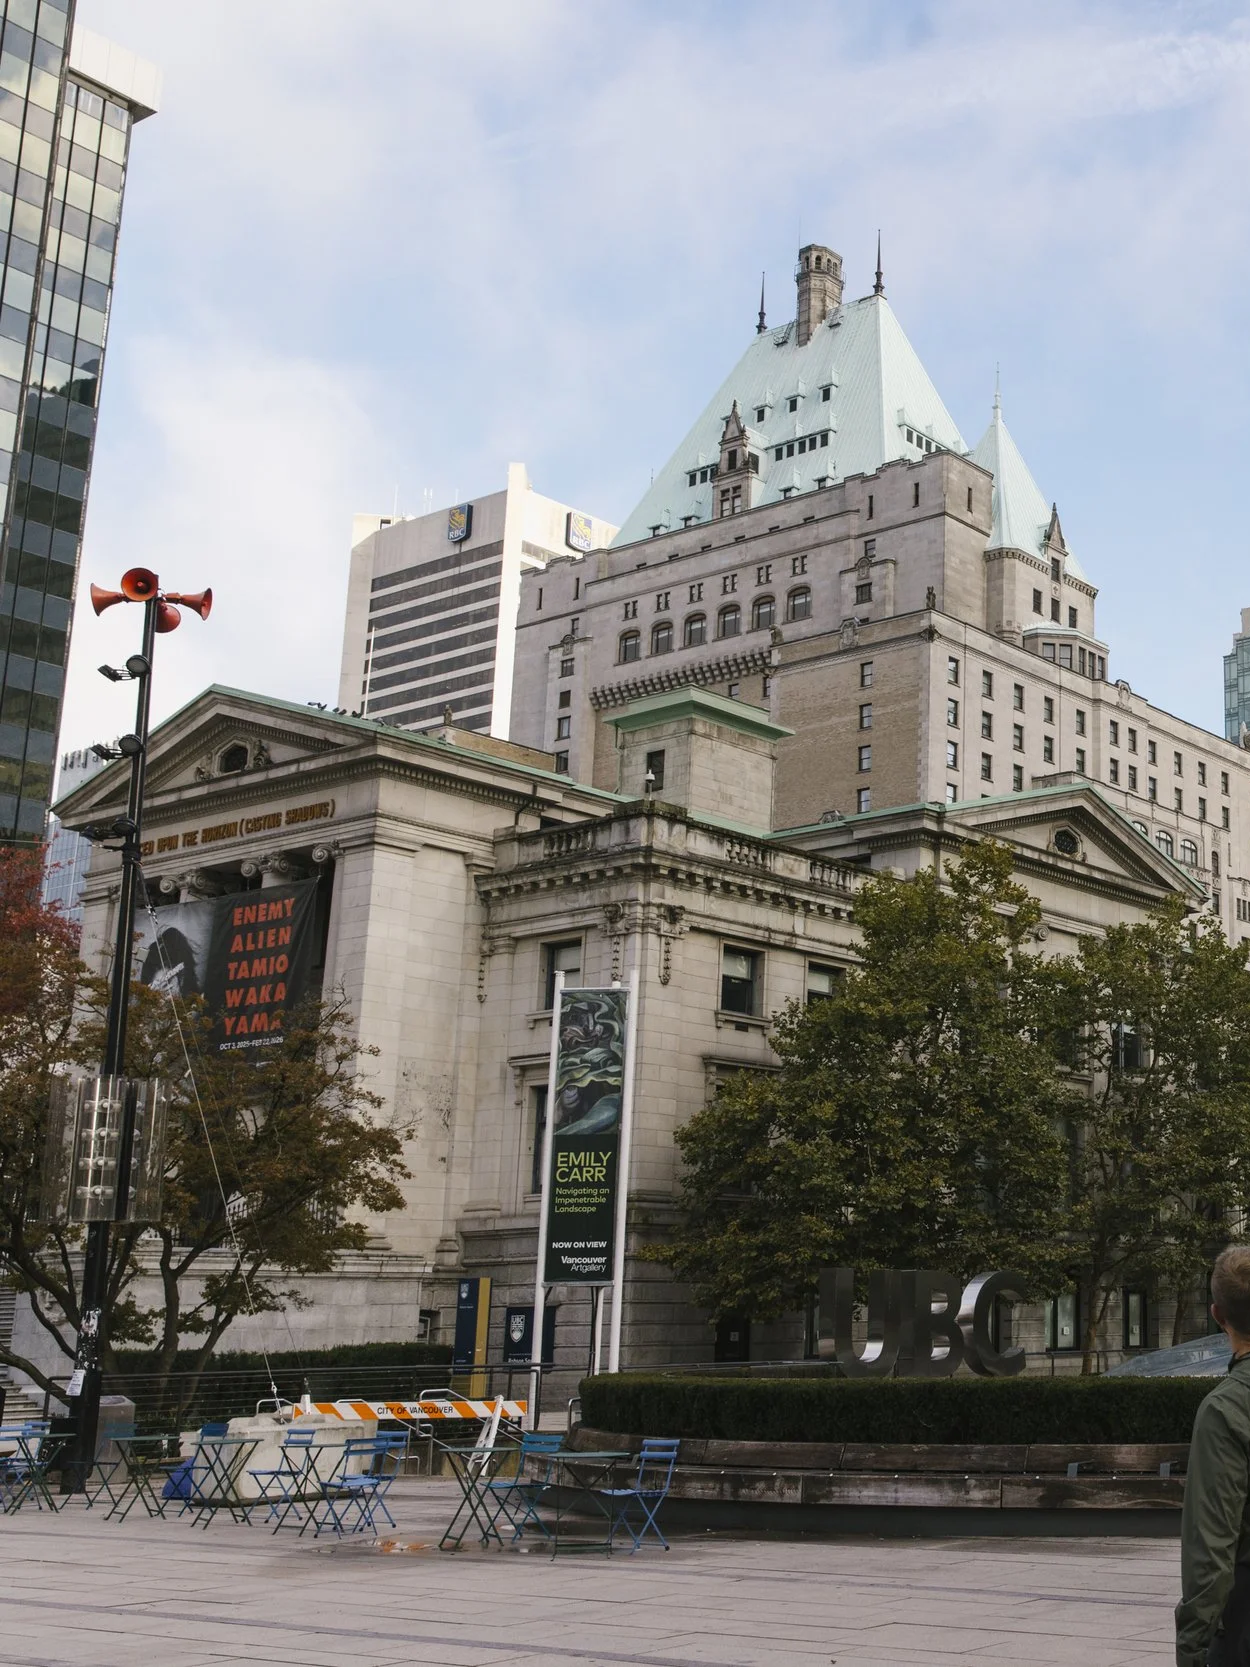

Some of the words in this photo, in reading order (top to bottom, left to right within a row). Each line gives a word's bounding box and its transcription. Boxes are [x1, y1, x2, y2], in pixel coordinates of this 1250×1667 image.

[449, 528, 465, 539] RBC
[571, 536, 591, 550] RBC
[157, 835, 179, 851] UPON
[181, 831, 199, 847] THE
[201, 822, 238, 844] HORIZON
[239, 813, 282, 835] (CASTING
[285, 799, 336, 824] SHADOWS)
[232, 897, 296, 927] ENEMY
[230, 925, 292, 953] ALIEN
[227, 953, 289, 981] TAMIO
[225, 982, 287, 1009] WAKA
[557, 1152, 612, 1167] EMILY
[556, 1167, 607, 1183] CARR
[555, 1187, 598, 1196] Navigating
[555, 1196, 607, 1205] Impenetrable
[554, 1205, 597, 1214] Landscape
[552, 1241, 573, 1249] NOW
[586, 1240, 607, 1248] VIEW
[561, 1255, 607, 1264] Vancouver
[570, 1263, 607, 1273] Artgallery
[818, 1268, 1029, 1378] UBC
[377, 1407, 395, 1415] CITY
[409, 1406, 454, 1414] VANCOUVER
